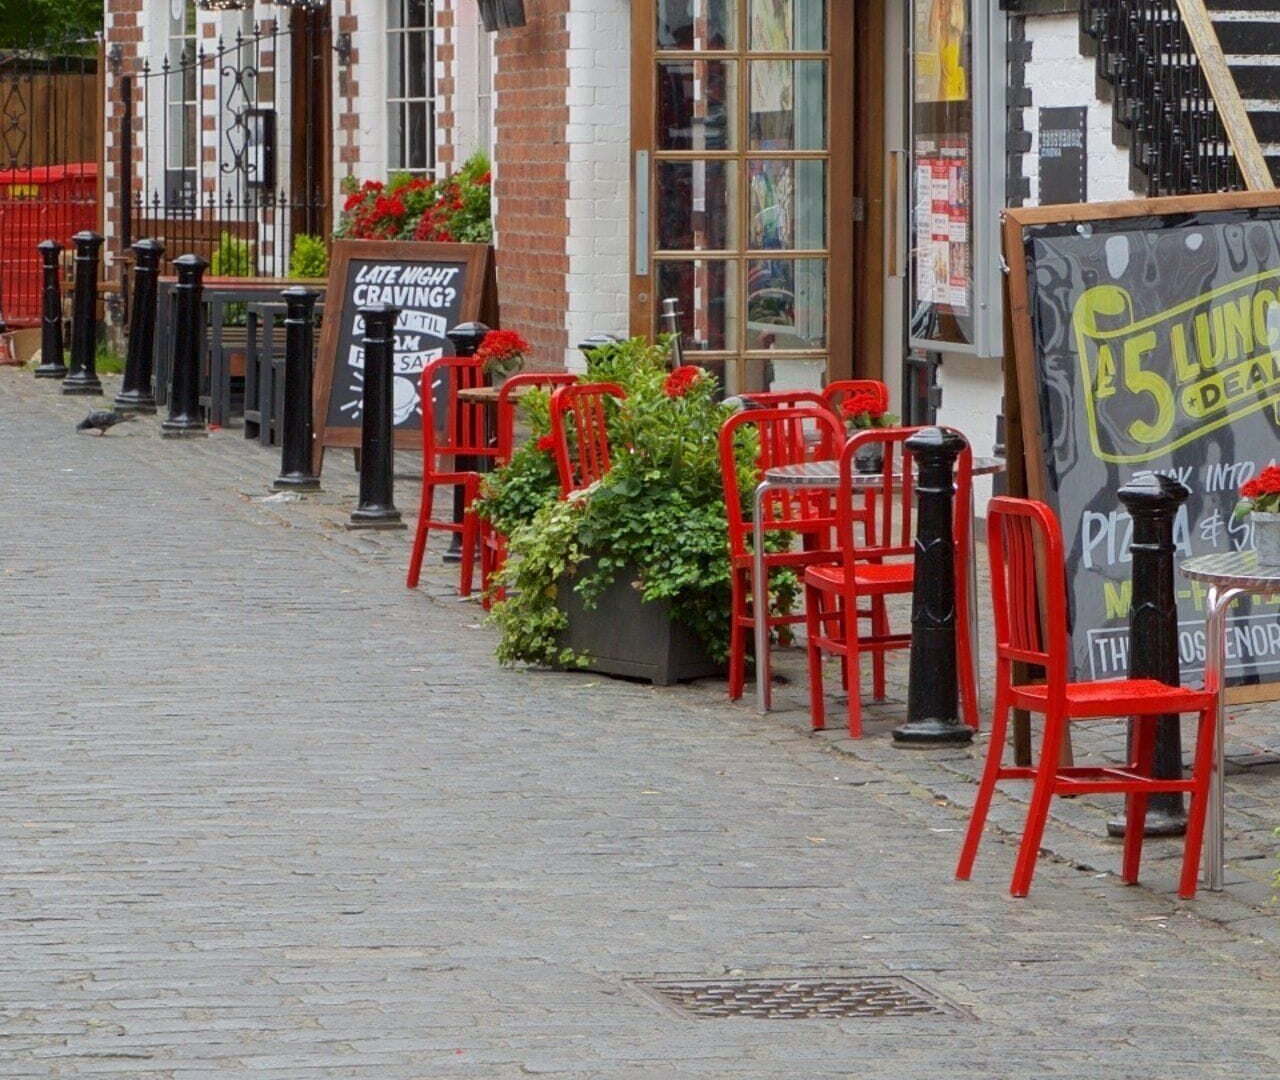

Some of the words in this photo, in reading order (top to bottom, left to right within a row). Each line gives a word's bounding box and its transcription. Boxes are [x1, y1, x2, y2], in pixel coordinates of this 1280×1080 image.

[355, 265, 402, 284] LATE
[398, 266, 459, 286] NIGHT
[353, 285, 456, 307] CRAVING?
[1206, 462, 1250, 492] INTO
[1200, 508, 1225, 547] &
[1095, 637, 1131, 672] TH
